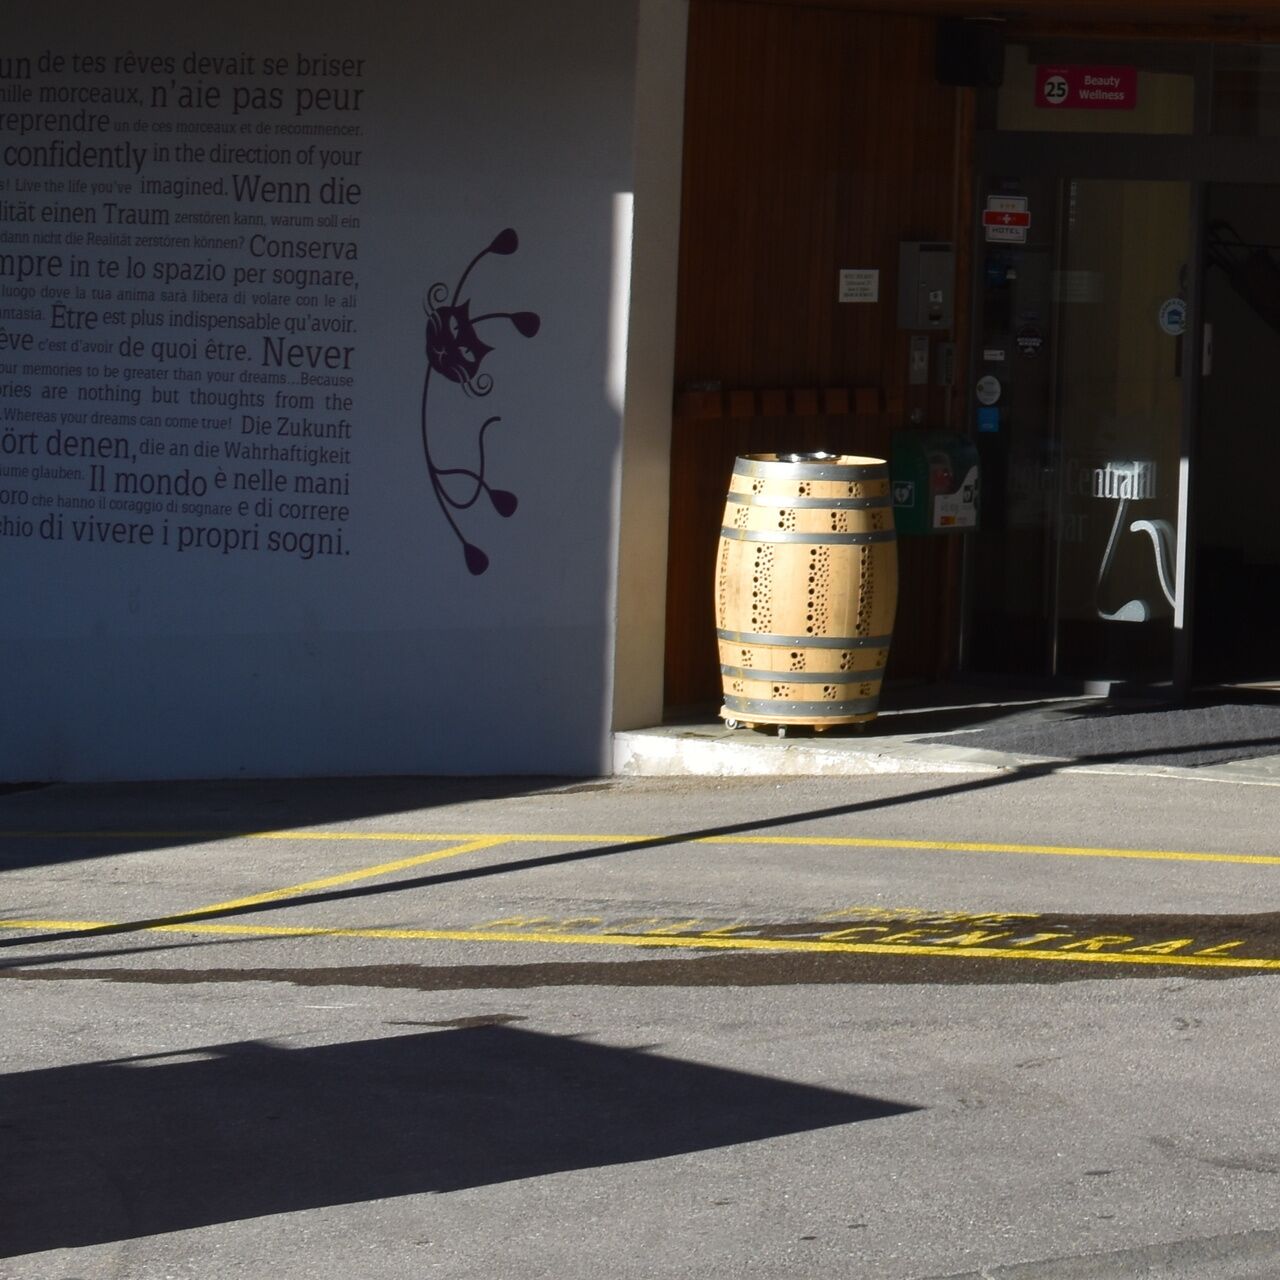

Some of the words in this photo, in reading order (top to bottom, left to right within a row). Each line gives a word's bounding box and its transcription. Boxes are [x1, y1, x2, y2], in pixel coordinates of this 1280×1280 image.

[37, 49, 65, 73] de
[72, 53, 107, 73] tes
[114, 50, 176, 74] rêves
[183, 51, 256, 75] devait
[263, 57, 289, 76] se
[296, 53, 366, 77] briser
[1046, 82, 1066, 97] 25
[1079, 89, 1125, 100] Wellness
[1084, 75, 1121, 88] Beauty
[39, 86, 144, 107] morceaux,
[150, 80, 221, 109] n'aie
[232, 86, 284, 115] pas
[295, 87, 365, 116] peur
[113, 122, 129, 132] un
[133, 120, 149, 132] de
[175, 122, 236, 134] morceaux
[240, 122, 251, 134] et
[255, 122, 272, 135] de
[275, 123, 364, 137] recommencer.
[4, 140, 148, 174] confidently
[153, 143, 170, 162] in
[175, 143, 205, 163] the
[209, 143, 292, 165] direction
[296, 145, 317, 165] of
[320, 149, 363, 169] your
[15, 178, 41, 192] Live
[44, 179, 65, 192] the
[68, 179, 88, 193] life
[90, 181, 133, 195] you've
[139, 176, 229, 199] imagined.
[232, 174, 311, 204] Wenn
[319, 177, 362, 205] die
[40, 202, 97, 224] einen
[103, 202, 170, 225] Traum
[174, 212, 231, 225] zerstören
[233, 212, 267, 227] kann,
[270, 215, 315, 228] warum
[316, 214, 339, 228] soll
[340, 215, 361, 229] ein
[33, 232, 61, 245] nicht
[65, 232, 84, 245] die
[86, 232, 131, 247] Realität
[134, 234, 190, 248] zerstören
[193, 235, 245, 249] können?
[250, 233, 359, 261] Conserva
[69, 254, 90, 278] in
[97, 258, 120, 279] te
[126, 256, 146, 280] lo
[152, 258, 226, 284] spazio
[233, 266, 267, 287] per
[272, 269, 360, 290] sognare,
[40, 285, 70, 299] dove
[75, 286, 86, 300] la
[91, 288, 112, 300] tua
[116, 289, 155, 302] anima
[160, 289, 187, 302] sarà
[192, 290, 229, 304] libera
[233, 291, 246, 305] di
[251, 292, 291, 306] volare
[295, 295, 319, 307] con
[324, 294, 336, 307] le
[340, 294, 357, 308] ali
[51, 300, 98, 330] Être
[102, 310, 126, 325] est
[130, 309, 165, 328] plus
[168, 311, 281, 332] indispensable
[284, 314, 357, 334] qu'avoir.
[38, 338, 67, 352] c'est
[70, 339, 113, 353] d'avoir
[119, 336, 145, 357] de
[151, 338, 197, 362] quoi
[205, 338, 252, 361] être.
[262, 336, 355, 369] Never
[22, 364, 82, 377] memories
[86, 365, 99, 377] to
[104, 365, 119, 378] be
[123, 368, 169, 381] greater
[173, 368, 201, 382] than
[207, 371, 235, 383] your
[41, 386, 68, 400] are
[78, 384, 141, 406] nothing
[151, 385, 180, 404] but
[190, 388, 265, 410] thoughts
[275, 391, 315, 409] from
[325, 393, 353, 411] the
[60, 411, 87, 425] your
[90, 412, 137, 427] dreams
[139, 416, 161, 427] can
[164, 417, 198, 429] come
[201, 418, 232, 430] true!
[241, 415, 272, 435] Die
[277, 417, 352, 439] Zukunft
[46, 429, 137, 464] denen,
[139, 438, 165, 455] die
[169, 443, 189, 456] an
[194, 440, 220, 458] die
[224, 440, 352, 466] Wahrhaftigkeit
[31, 464, 85, 480] glauben.
[89, 464, 105, 492] Il
[114, 469, 208, 496] mondo
[214, 466, 227, 489] è
[233, 468, 288, 492] nelle
[293, 472, 350, 496] mani
[31, 494, 54, 506] che
[57, 495, 95, 509] hanno
[108, 500, 163, 515] coraggio
[166, 500, 178, 513] di
[181, 502, 232, 516] sognare
[237, 499, 249, 516] e
[254, 497, 273, 518] di
[278, 503, 350, 521] correre
[39, 513, 64, 540] di
[72, 515, 154, 545] vivere
[161, 518, 169, 546] i
[176, 523, 259, 555] propri
[267, 528, 351, 560] sogni.
